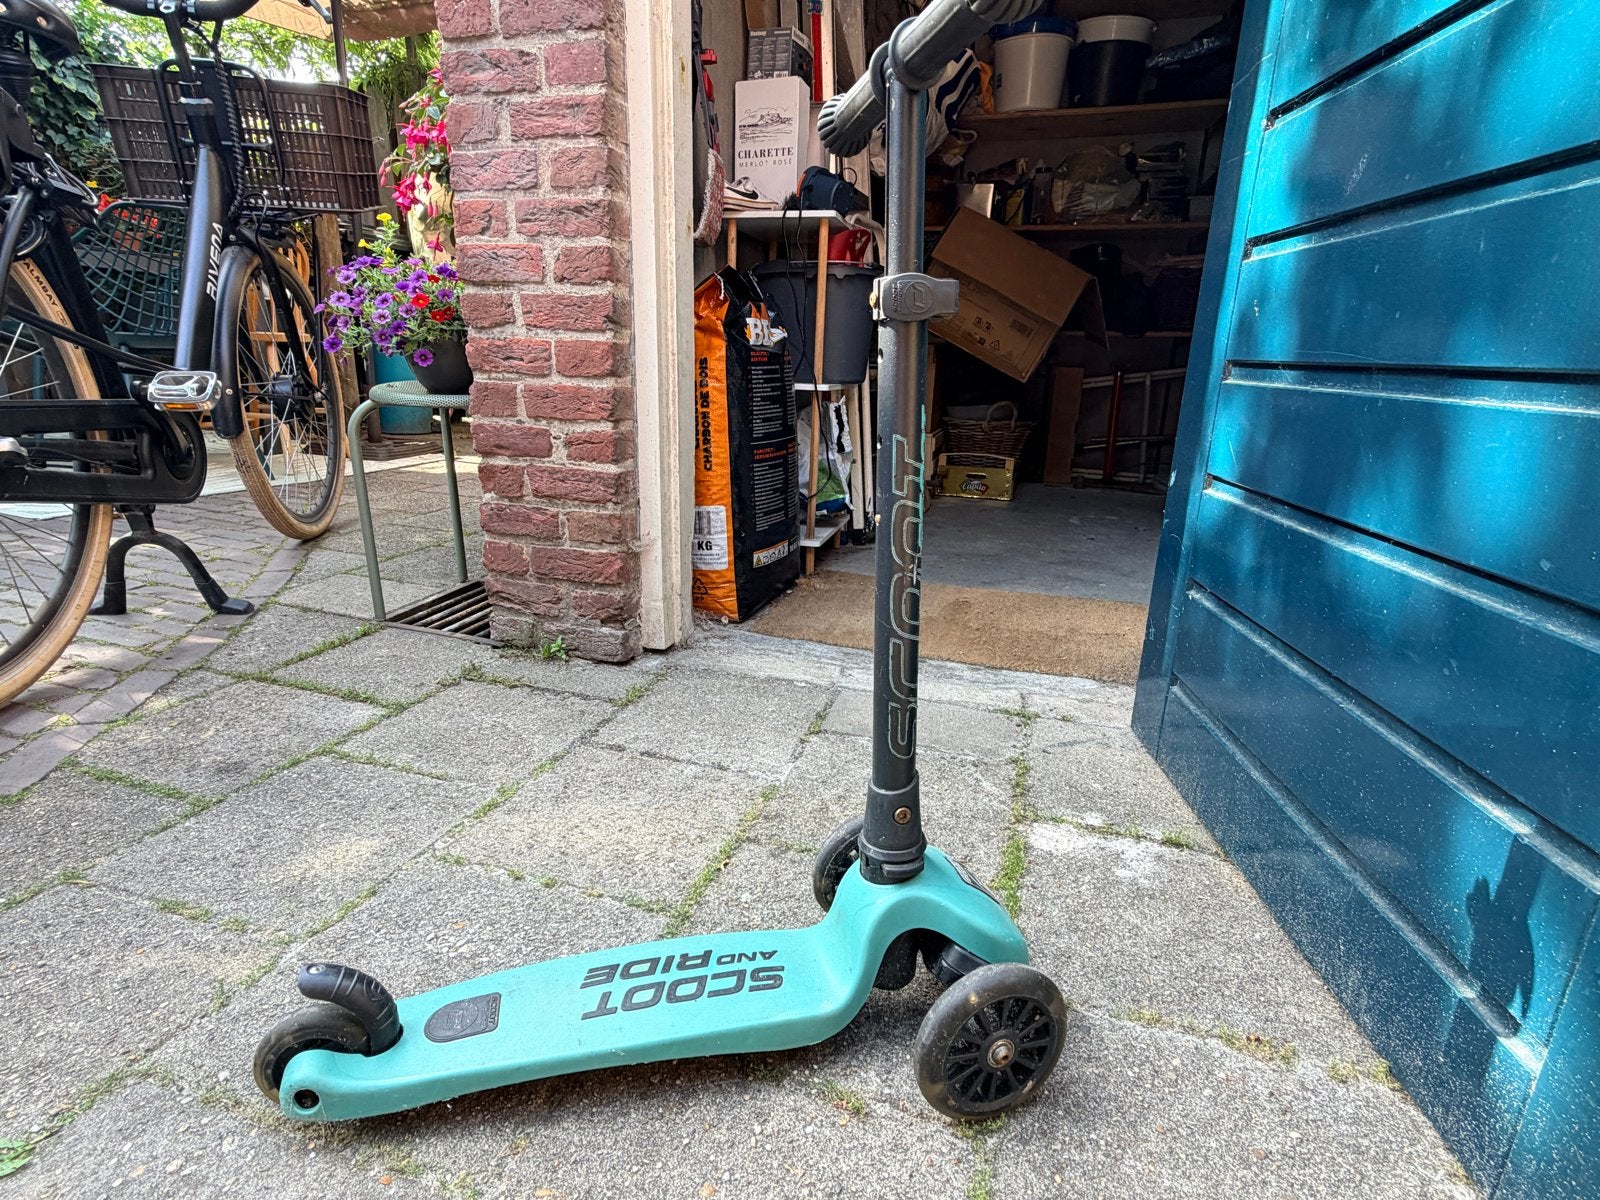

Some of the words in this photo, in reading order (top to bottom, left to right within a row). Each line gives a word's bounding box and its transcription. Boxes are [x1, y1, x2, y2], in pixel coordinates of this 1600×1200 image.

[737, 146, 794, 160] CHARETTE
[739, 160, 769, 168] MERLOT
[23, 261, 58, 307] ALMBAY
[698, 356, 709, 389] BOIS
[699, 390, 710, 409] DE
[700, 410, 713, 472] CHARBON
[697, 540, 713, 552] KG
[887, 433, 924, 759] SCOOT
[579, 949, 713, 990] RIDE
[716, 950, 778, 966] AND
[580, 965, 785, 1021] SCOOT
